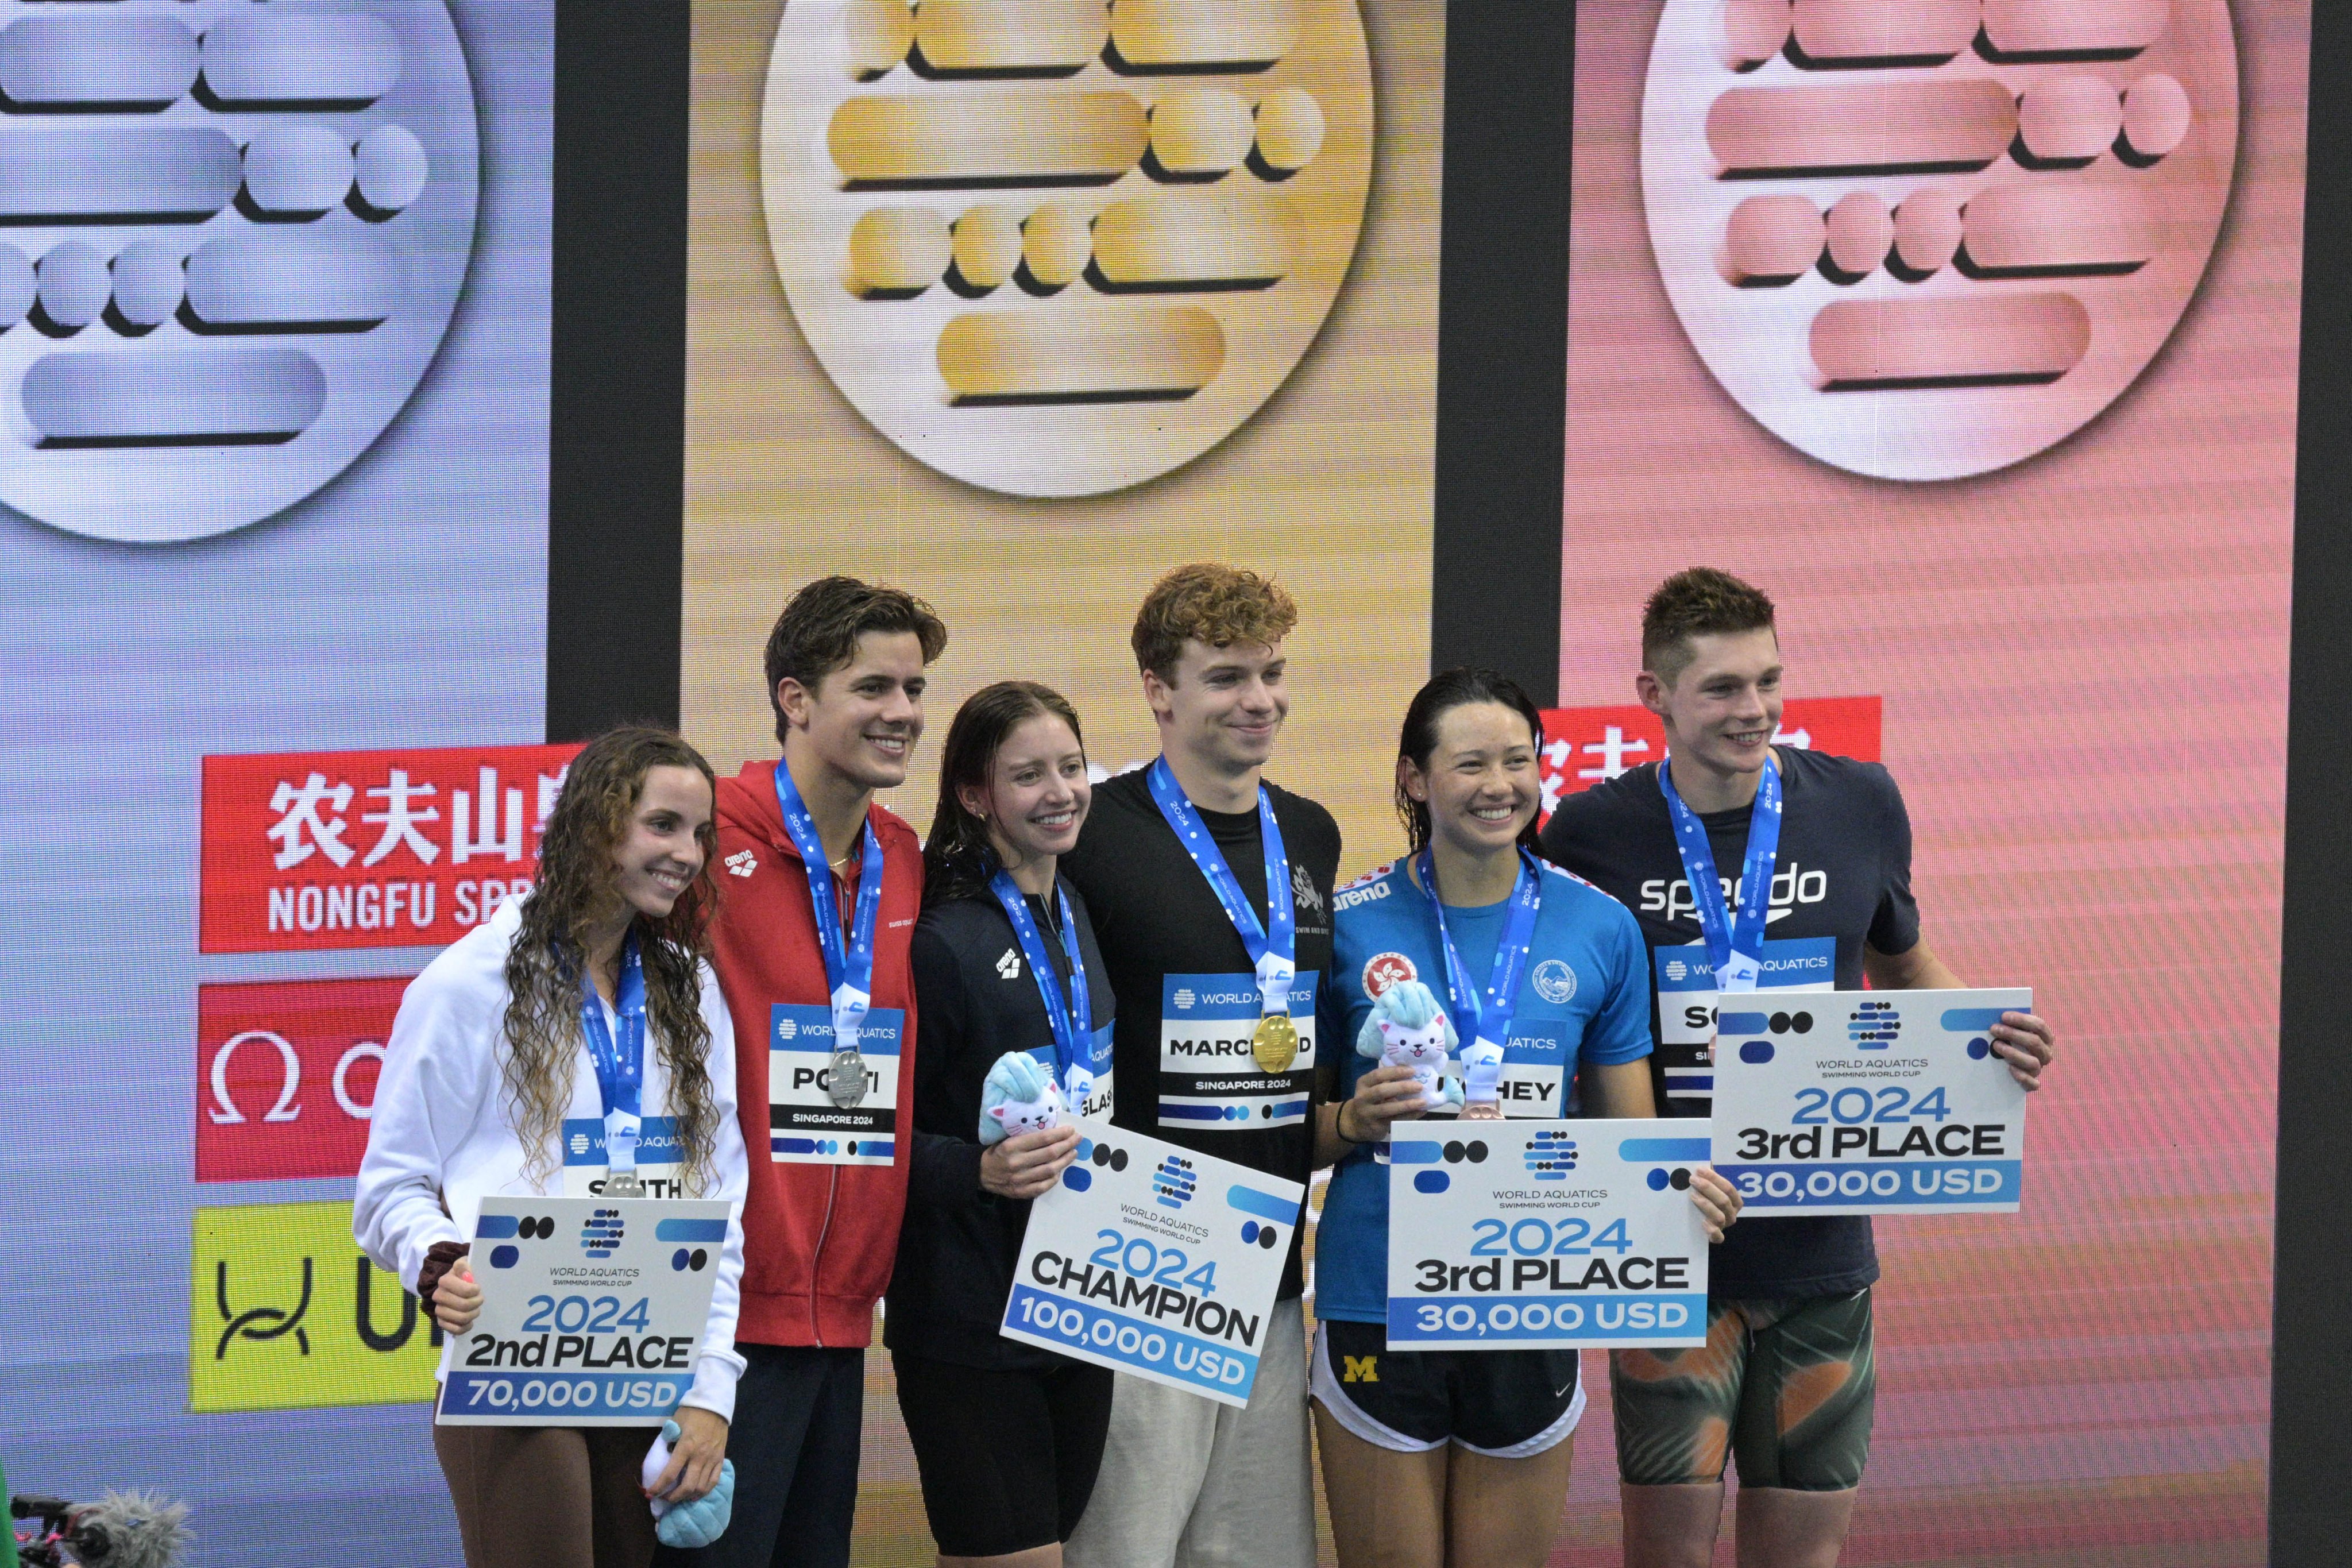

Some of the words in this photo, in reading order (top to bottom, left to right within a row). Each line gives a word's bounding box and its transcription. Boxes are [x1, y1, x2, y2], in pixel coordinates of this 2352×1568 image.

[1764, 783, 1772, 809] 2024
[789, 813, 806, 840] 2024
[1169, 801, 1189, 827] 2024
[724, 849, 754, 867] arena
[1273, 858, 1282, 887] AQUATICS
[1751, 883, 1759, 907] WORLD
[1755, 851, 1764, 883] AQUATICS
[269, 882, 435, 932] NONGFU
[1216, 872, 1230, 895] WORLD
[1228, 894, 1247, 924] AQUATICS
[1522, 883, 1533, 906] 2024
[1699, 872, 1709, 897] WORLD
[1706, 896, 1718, 928] AQUATICS
[1007, 897, 1025, 924] 2024
[995, 948, 1016, 972] arena
[1500, 973, 1509, 996] WORLD
[1505, 945, 1517, 973] AQUATICS
[1759, 957, 1828, 971] AQUATICS
[1202, 993, 1252, 1004] WORLD
[1253, 990, 1311, 1003] AATICS
[802, 1025, 836, 1036] WORL
[856, 1028, 895, 1039] QUATICS
[1170, 1037, 1311, 1056] MARCD
[1505, 1037, 1557, 1049] UATICS
[1816, 1060, 1863, 1069] WORLD
[1866, 1059, 1929, 1068] AQUATICS
[1195, 1079, 1265, 1090] SINGAPORE
[1267, 1079, 1291, 1089] 2024
[792, 1113, 852, 1125] SINGAPORE
[853, 1115, 873, 1125] 2024
[1791, 1086, 1951, 1125] 2024
[1736, 1126, 1821, 1160] 3rd
[1832, 1124, 2006, 1158] PLACE
[1493, 1191, 1541, 1199] WORLD
[1543, 1189, 1608, 1199] AQUATICS
[1737, 1170, 1901, 1203] 30,000
[1912, 1168, 2003, 1196] USD
[1121, 1203, 1158, 1222] WORLD
[1158, 1216, 1209, 1238] AQUATICS
[1122, 1216, 1158, 1233] SWIMMING
[1159, 1228, 1185, 1241] WORLD
[1185, 1236, 1201, 1245] CUP
[1470, 1218, 1633, 1256] 2024
[550, 1267, 588, 1276] WORLD
[589, 1268, 640, 1277] AQUATICS
[1089, 1229, 1216, 1297] 2024
[1414, 1258, 1501, 1292] 3rd
[1512, 1257, 1690, 1292] PLACE
[1032, 1250, 1260, 1347] CHAMPION
[521, 1295, 650, 1334] 2024
[1416, 1303, 1585, 1337] 30,000
[1596, 1302, 1689, 1330] USD
[465, 1333, 550, 1368] 2nd
[553, 1335, 694, 1369] PLACE
[1021, 1297, 1167, 1363] 100,000
[1173, 1342, 1246, 1385] USD
[1343, 1355, 1378, 1382] M
[468, 1380, 597, 1412] 70,000
[605, 1381, 678, 1408] USD
